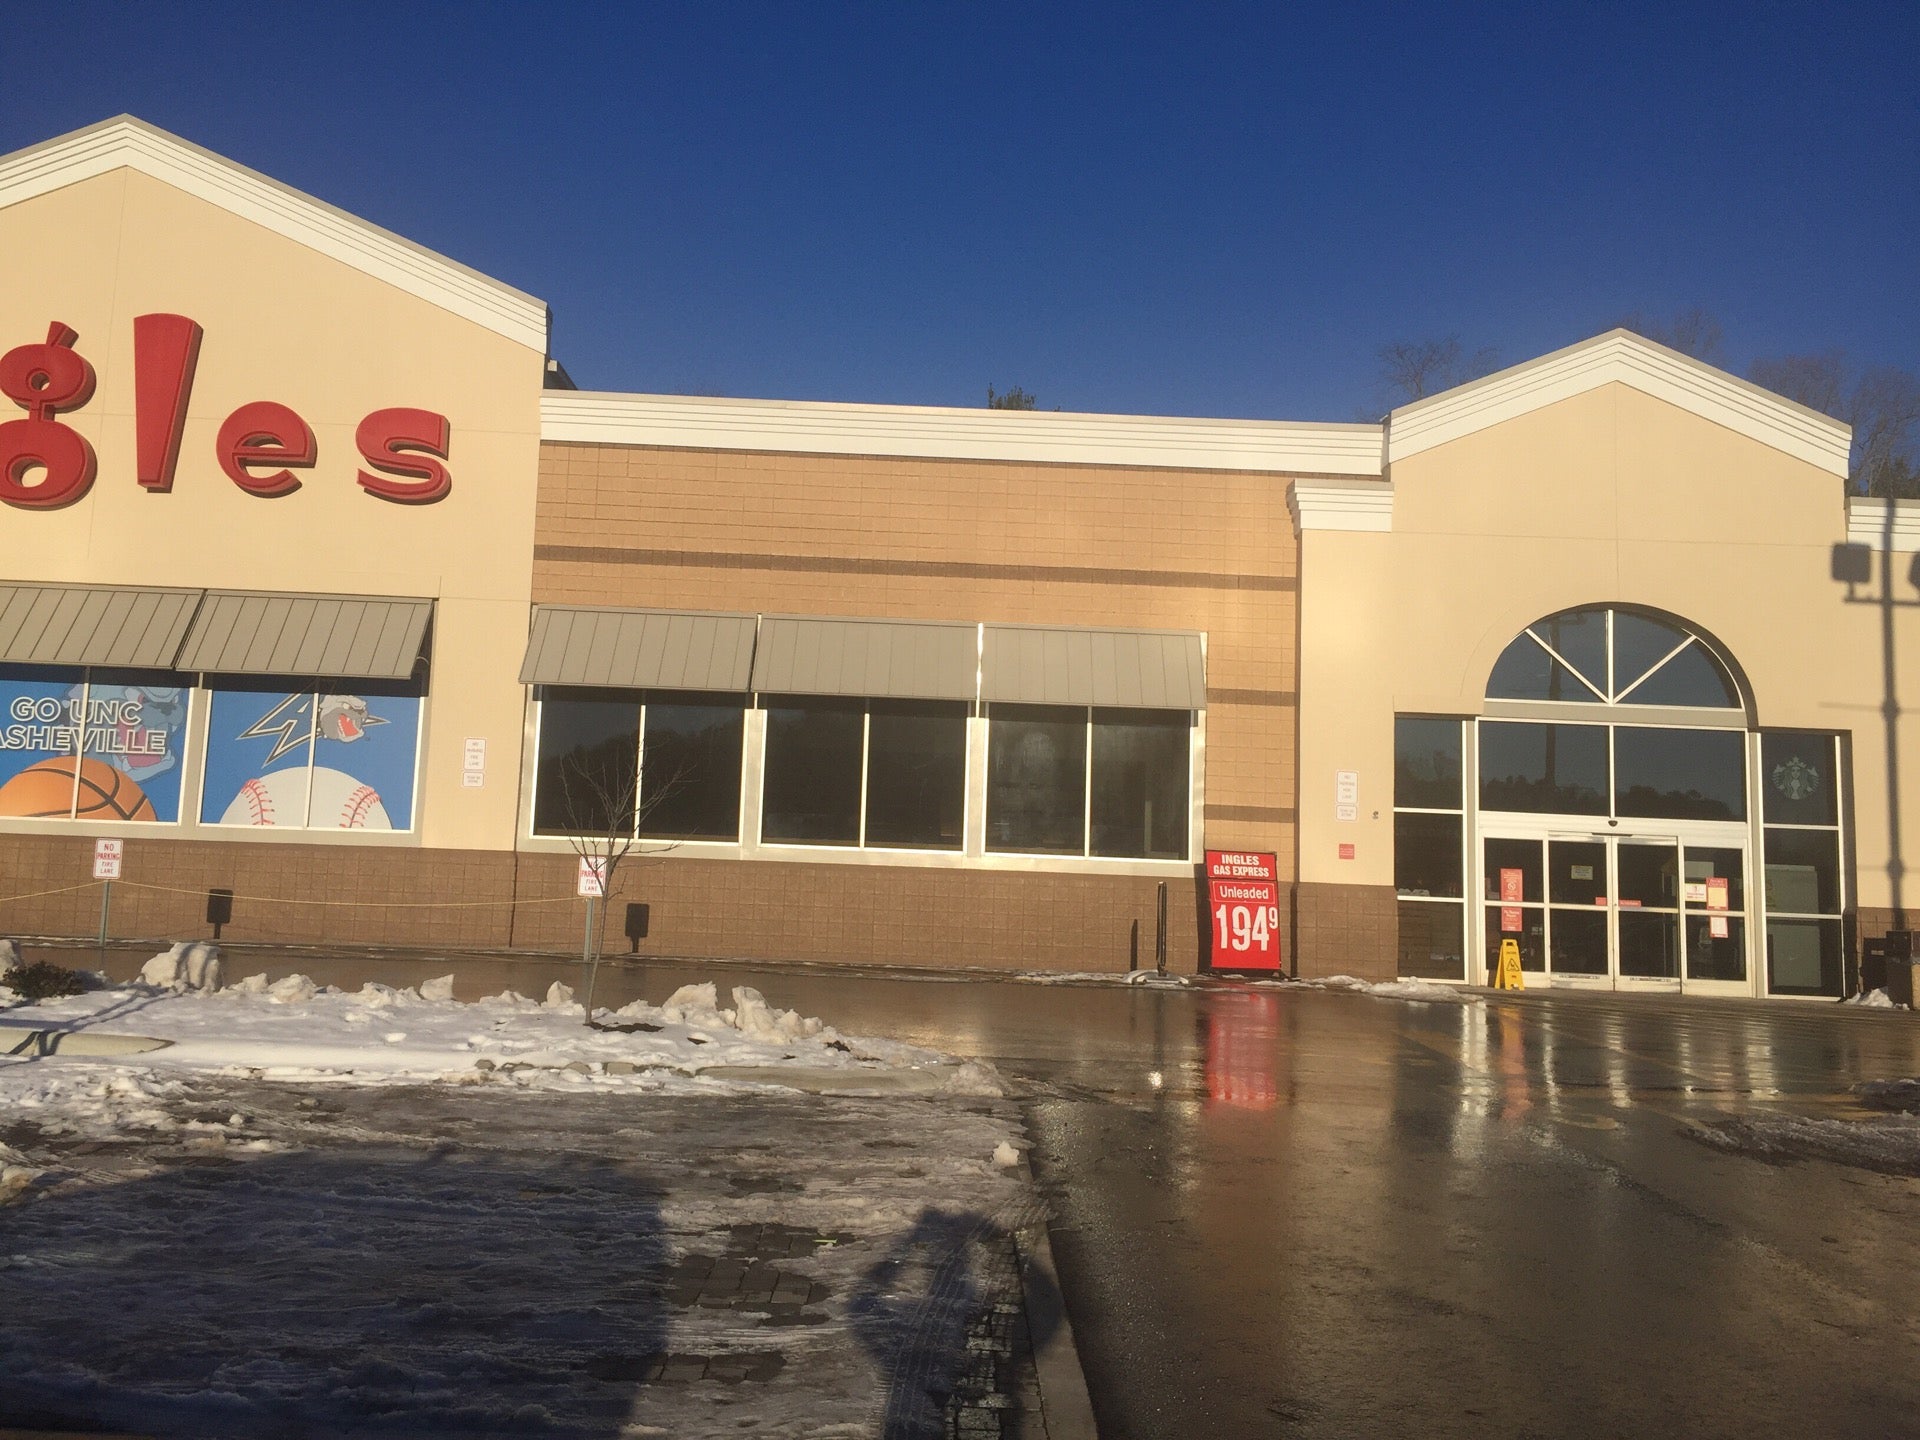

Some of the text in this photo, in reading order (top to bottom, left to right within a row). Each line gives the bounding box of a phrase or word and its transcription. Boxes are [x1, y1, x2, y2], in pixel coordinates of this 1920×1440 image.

[10, 696, 143, 726] GO UNC
[104, 843, 114, 851] NO
[96, 852, 120, 860] PARKING
[1221, 854, 1259, 866] INGLES
[1213, 865, 1269, 877] GAS EXPRESS
[1219, 885, 1269, 900] Unleaded
